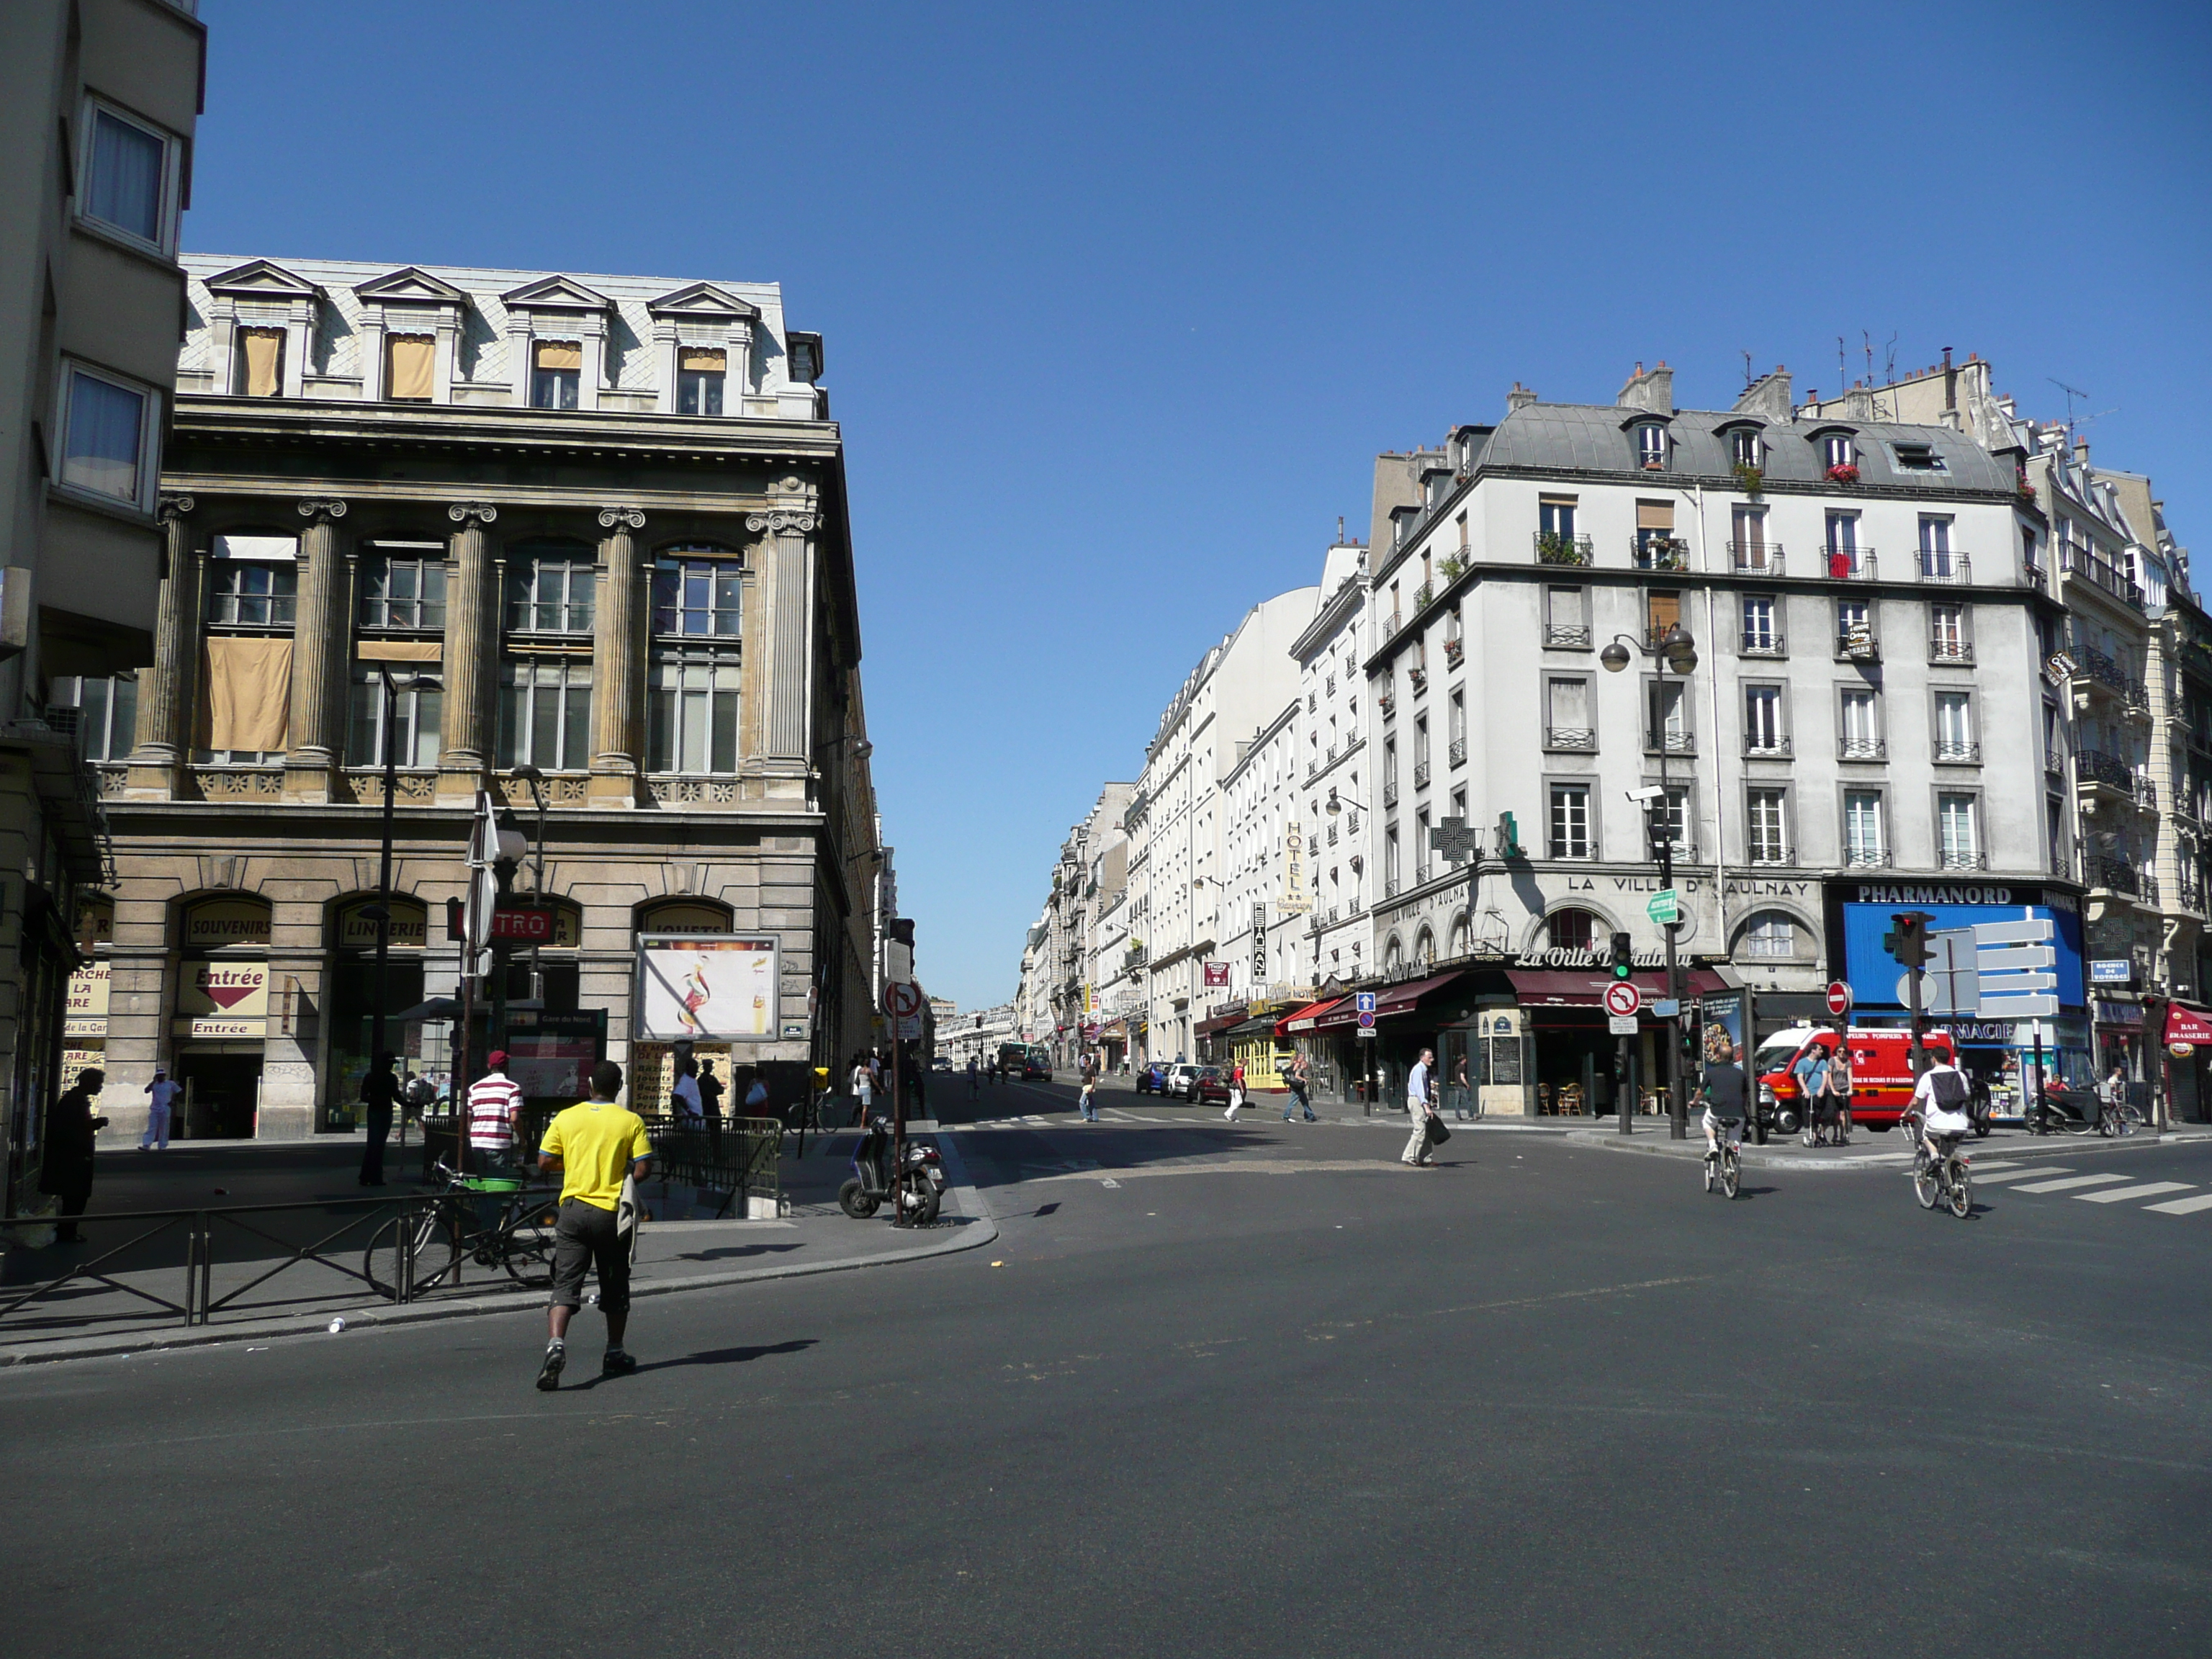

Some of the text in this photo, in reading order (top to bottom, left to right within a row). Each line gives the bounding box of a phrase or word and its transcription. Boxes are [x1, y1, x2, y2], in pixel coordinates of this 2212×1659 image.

[1287, 822, 1302, 891] HOTEL
[1568, 877, 1595, 891] LA
[1858, 885, 2012, 904] PHARMANORD
[1392, 909, 1400, 924] LA
[1401, 902, 1421, 920] VILLE
[192, 920, 271, 935] SOUVENIRS
[347, 922, 423, 936] LINERIE
[1254, 903, 1265, 976] RESTAURANT
[1514, 948, 1543, 966] La
[1545, 948, 1594, 966] Ville
[195, 968, 264, 985] Entrée
[73, 984, 91, 993] LA
[65, 998, 90, 1007] ARE
[90, 1023, 107, 1033] Gar
[194, 1023, 248, 1033] Entrée
